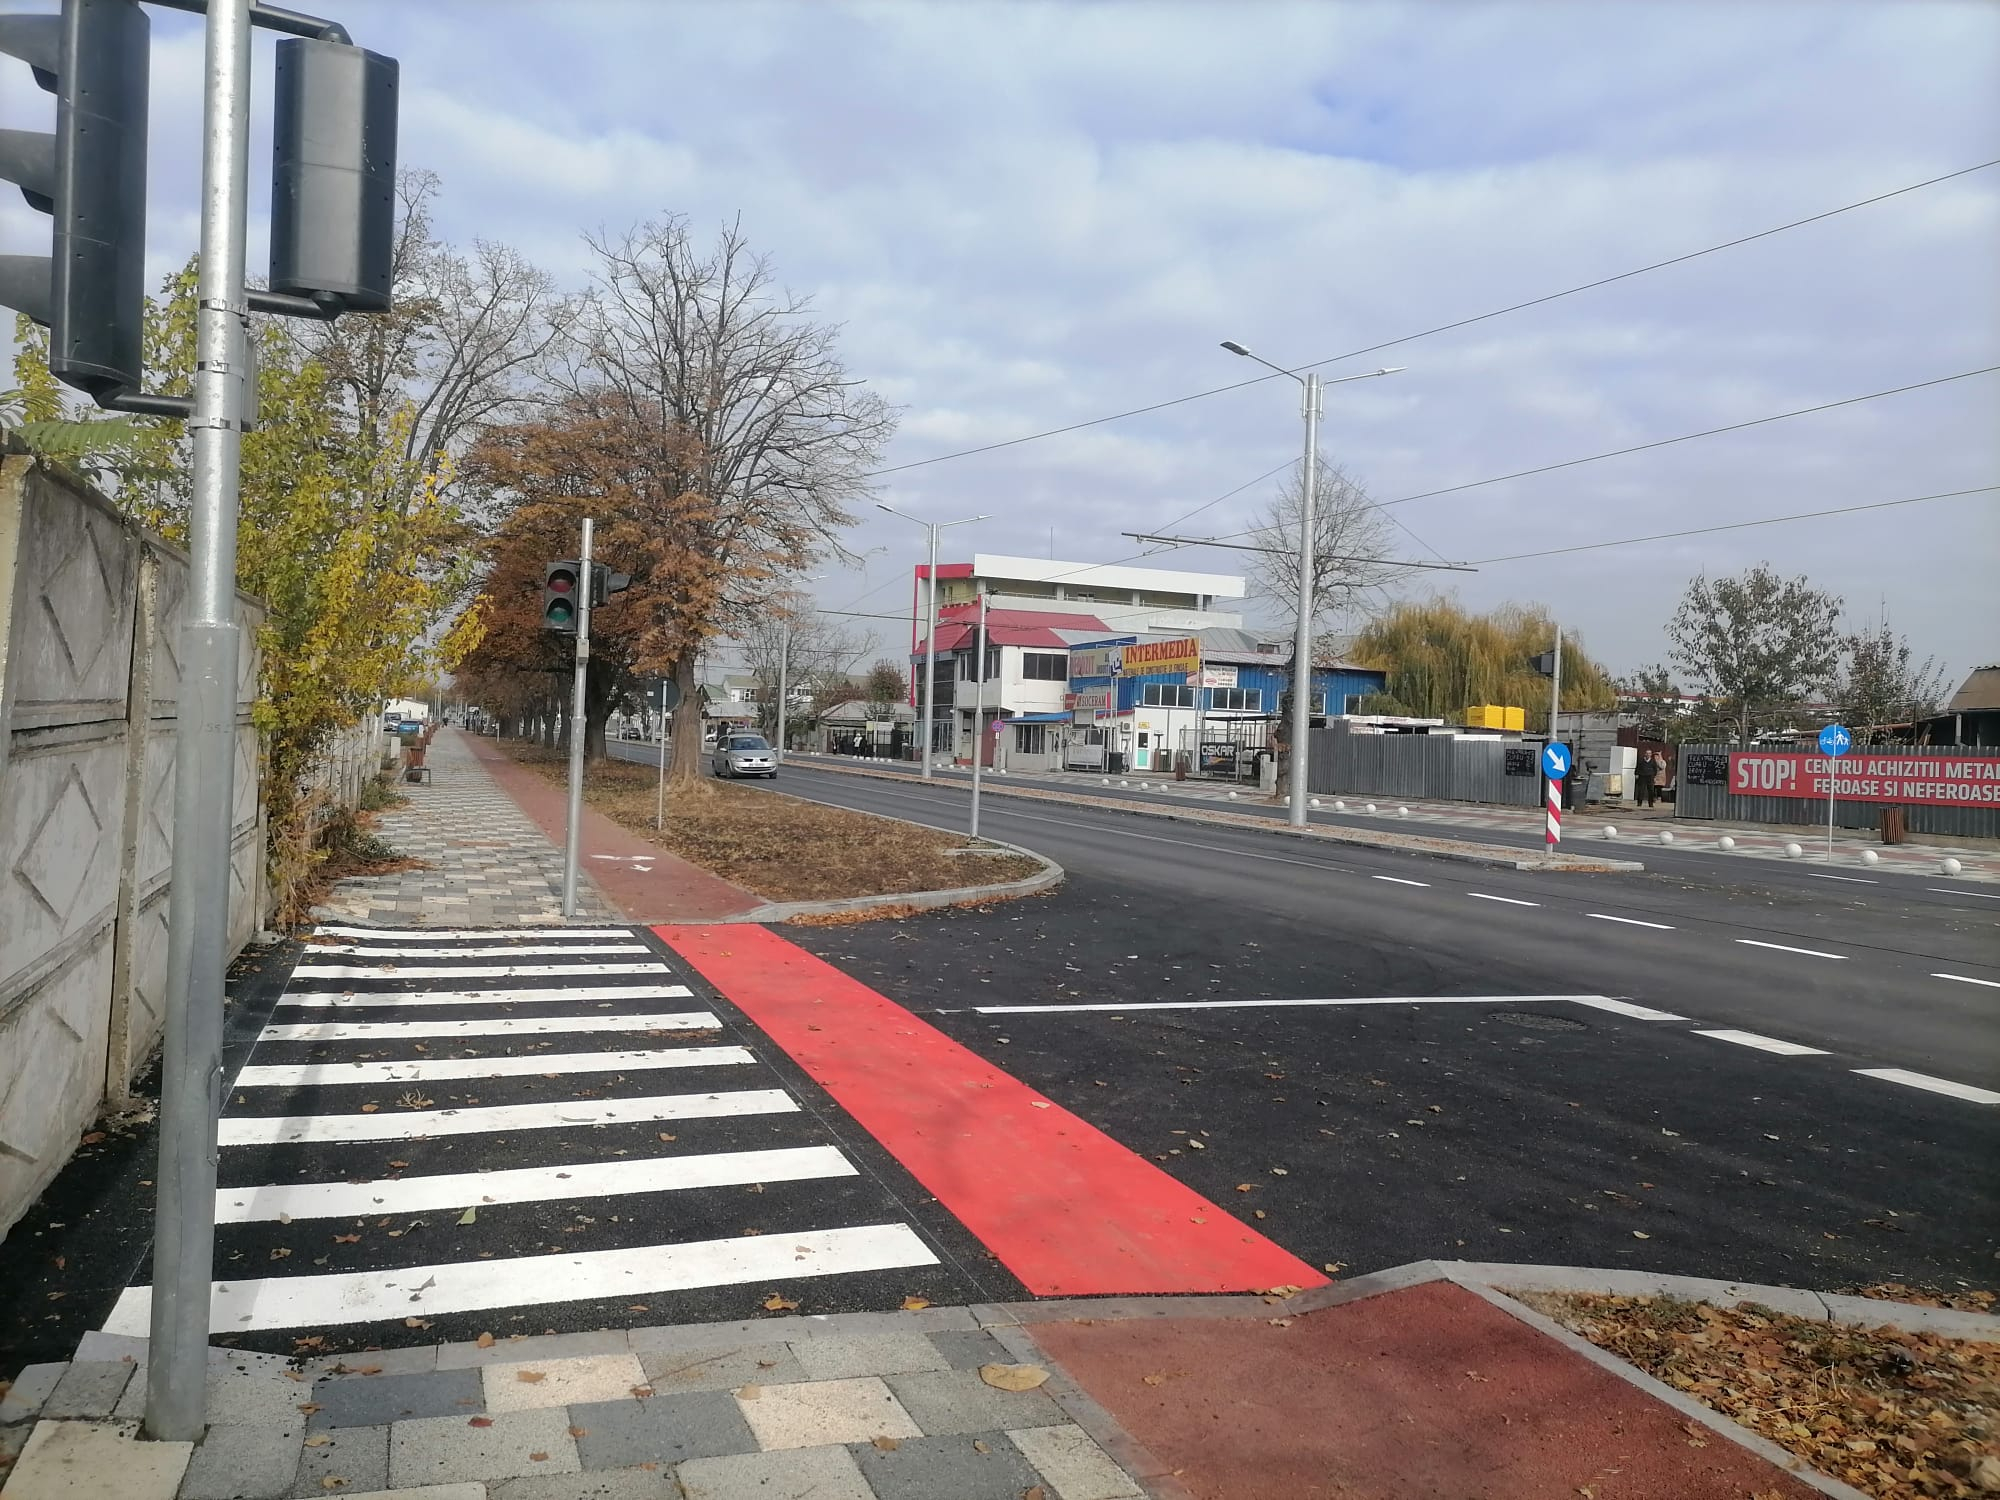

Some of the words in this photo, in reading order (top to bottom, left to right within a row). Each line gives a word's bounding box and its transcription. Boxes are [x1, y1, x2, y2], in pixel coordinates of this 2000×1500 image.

[1125, 638, 1198, 664] INTERMEDIA
[1201, 744, 1234, 756] OSKAR
[1737, 758, 1797, 791] STOP!
[1804, 758, 1863, 776] CENTRU
[1866, 760, 1940, 778] ACHIZITII
[1813, 778, 1879, 796] FEROASE
[1883, 780, 1898, 797] SI
[1903, 782, 2000, 802] NEFEROASE
